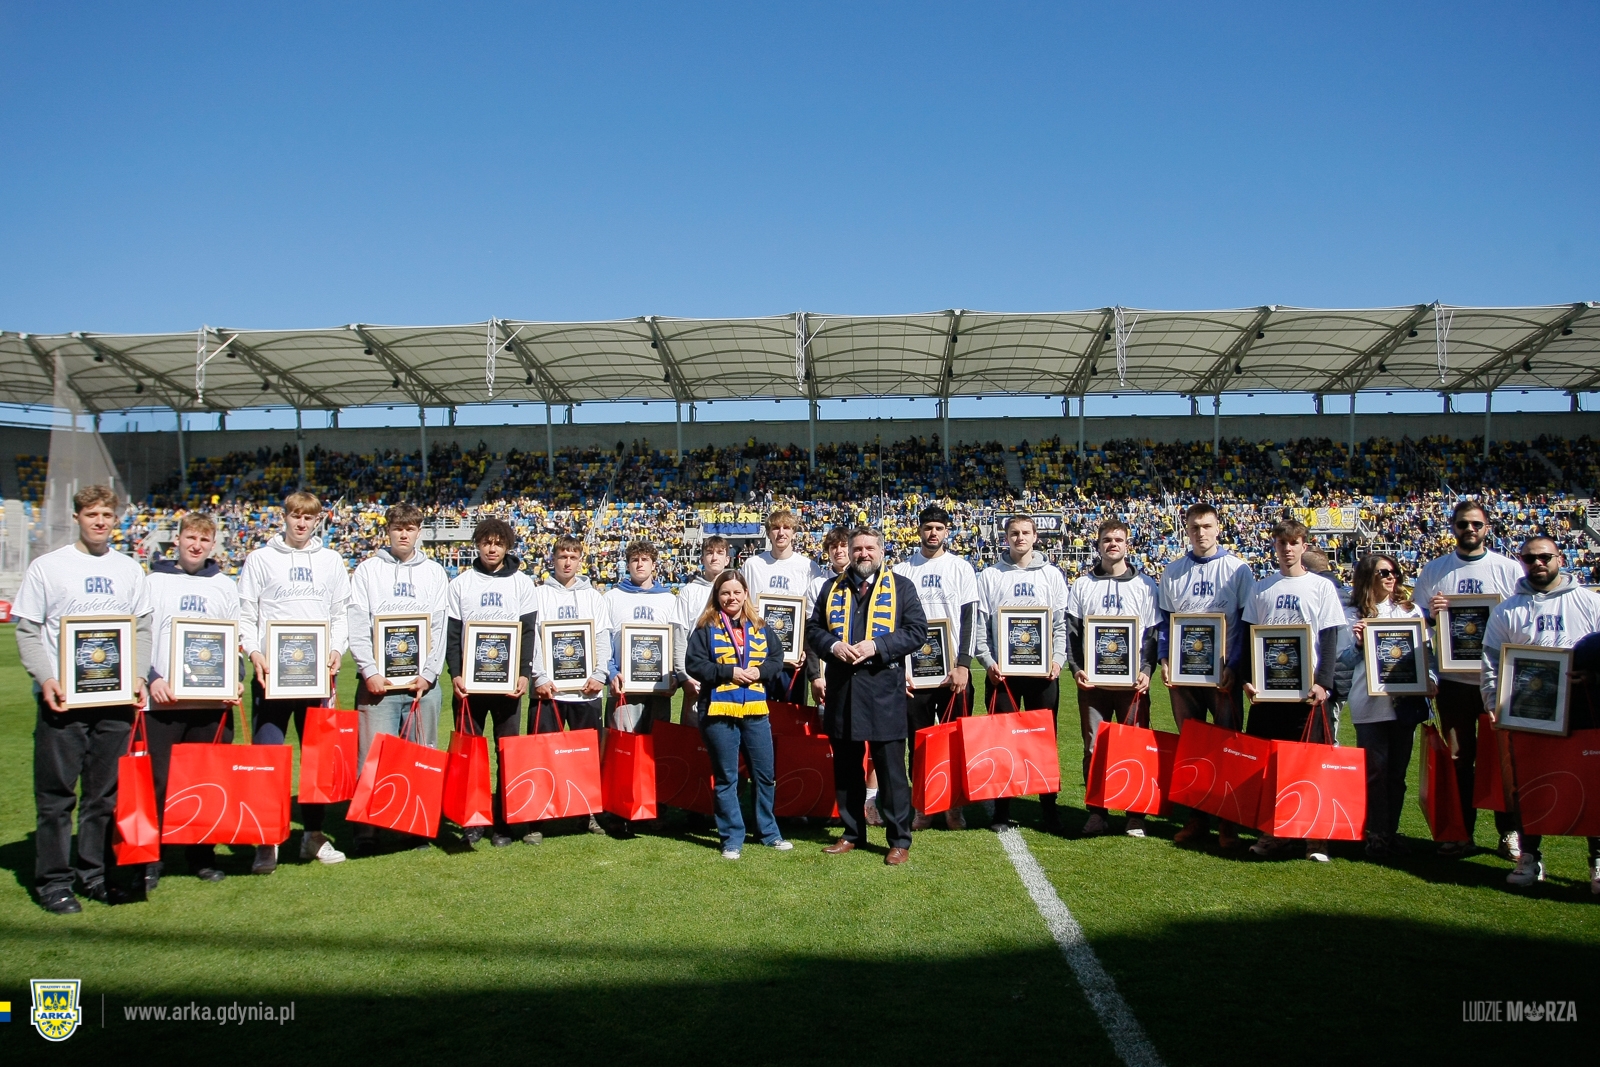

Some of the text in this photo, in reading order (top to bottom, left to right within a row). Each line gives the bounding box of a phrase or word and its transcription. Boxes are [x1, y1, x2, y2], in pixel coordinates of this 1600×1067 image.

[290, 567, 313, 582] GAK
[921, 574, 942, 589] GAK
[85, 577, 114, 594] GAK
[769, 575, 790, 590] GAK
[1014, 582, 1035, 597] GAK
[1192, 581, 1214, 596] GAK
[1457, 578, 1483, 594] GAK
[274, 585, 327, 600] basketball
[480, 592, 503, 607] GAK
[919, 590, 955, 601] sketball
[65, 598, 131, 614] basketball
[180, 595, 207, 613] GAK
[376, 600, 431, 614] basketball
[1102, 594, 1123, 609] GAK
[1178, 600, 1229, 613] basketball
[1276, 594, 1301, 611] GAK
[464, 610, 518, 622] basketball
[558, 605, 579, 619] GAK
[633, 605, 655, 621] GAK
[1536, 614, 1564, 632] GAK
